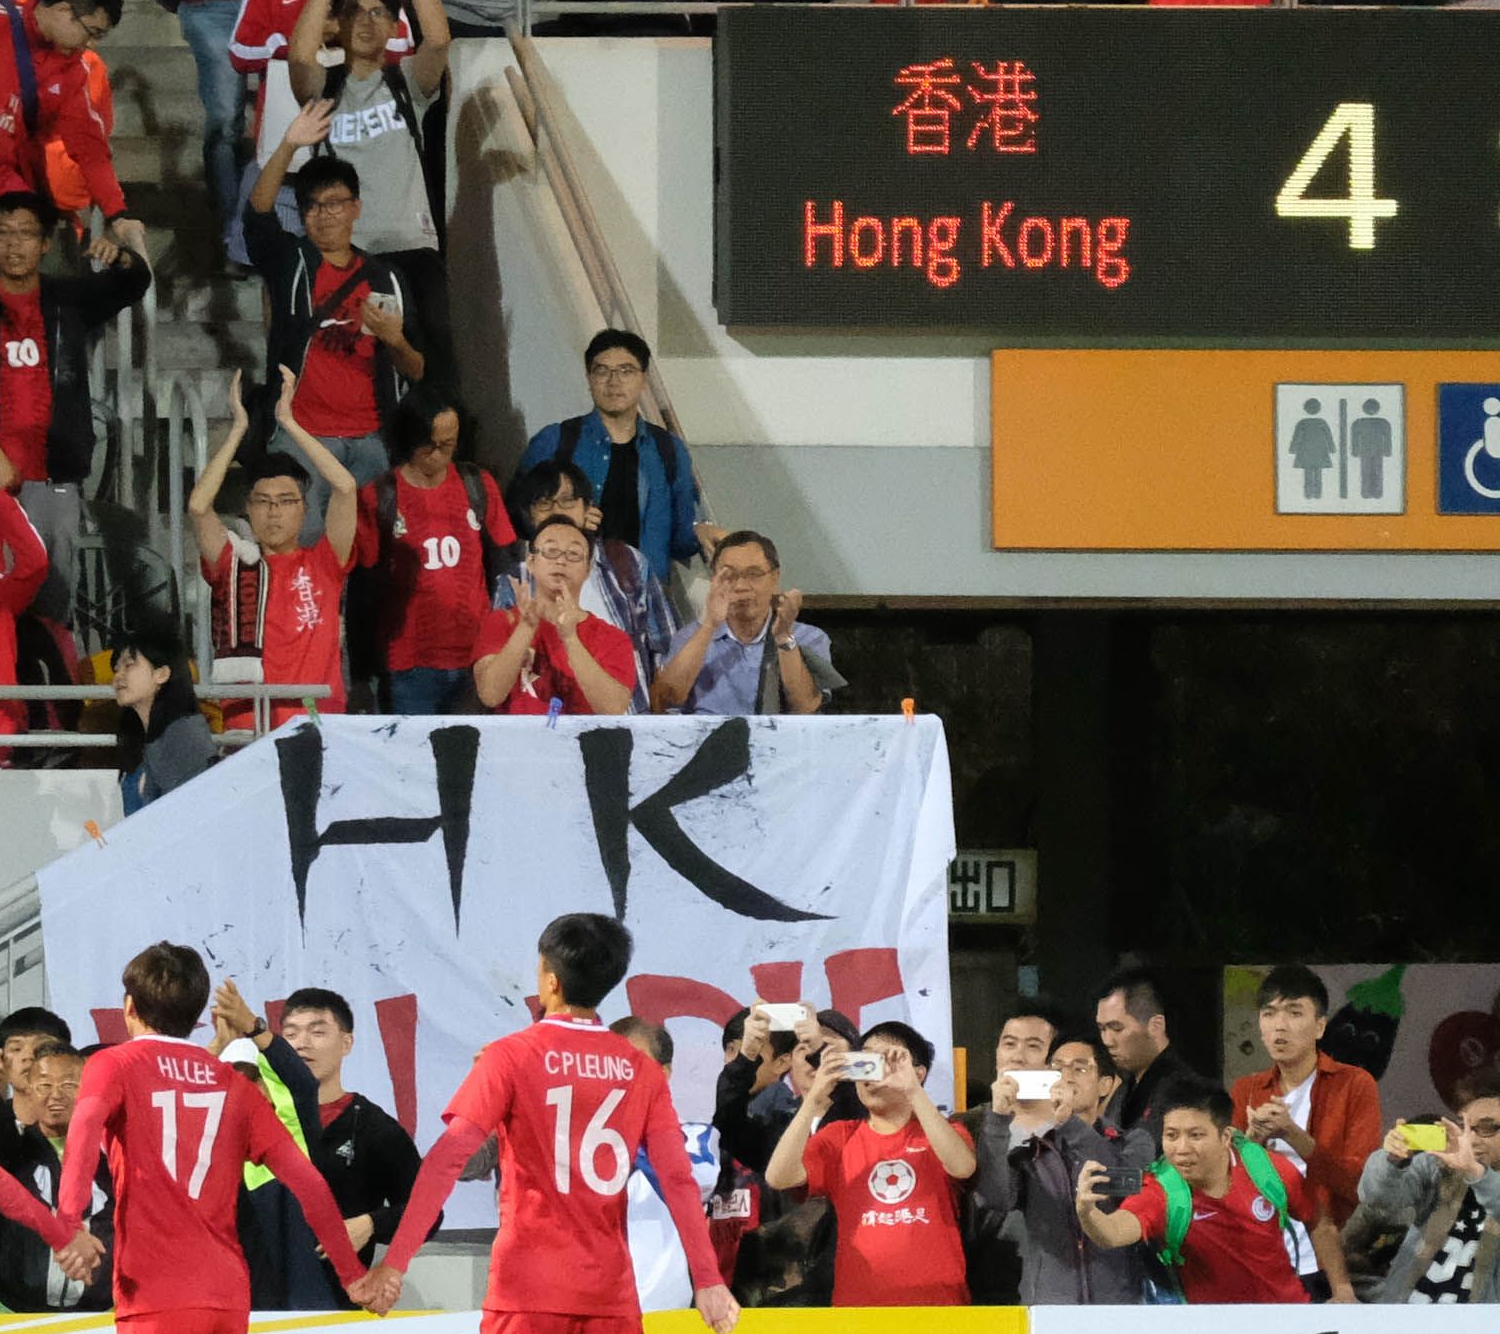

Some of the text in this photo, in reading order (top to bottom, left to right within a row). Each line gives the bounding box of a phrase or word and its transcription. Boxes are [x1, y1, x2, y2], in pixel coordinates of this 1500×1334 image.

[892, 57, 1041, 156] 香港
[1274, 102, 1398, 250] 4
[803, 199, 1132, 289] Hong Kong
[5, 337, 41, 368] 10
[423, 535, 461, 570] 10
[272, 716, 839, 950] HK
[150, 1088, 228, 1202] 17
[544, 1083, 631, 1198] 16
